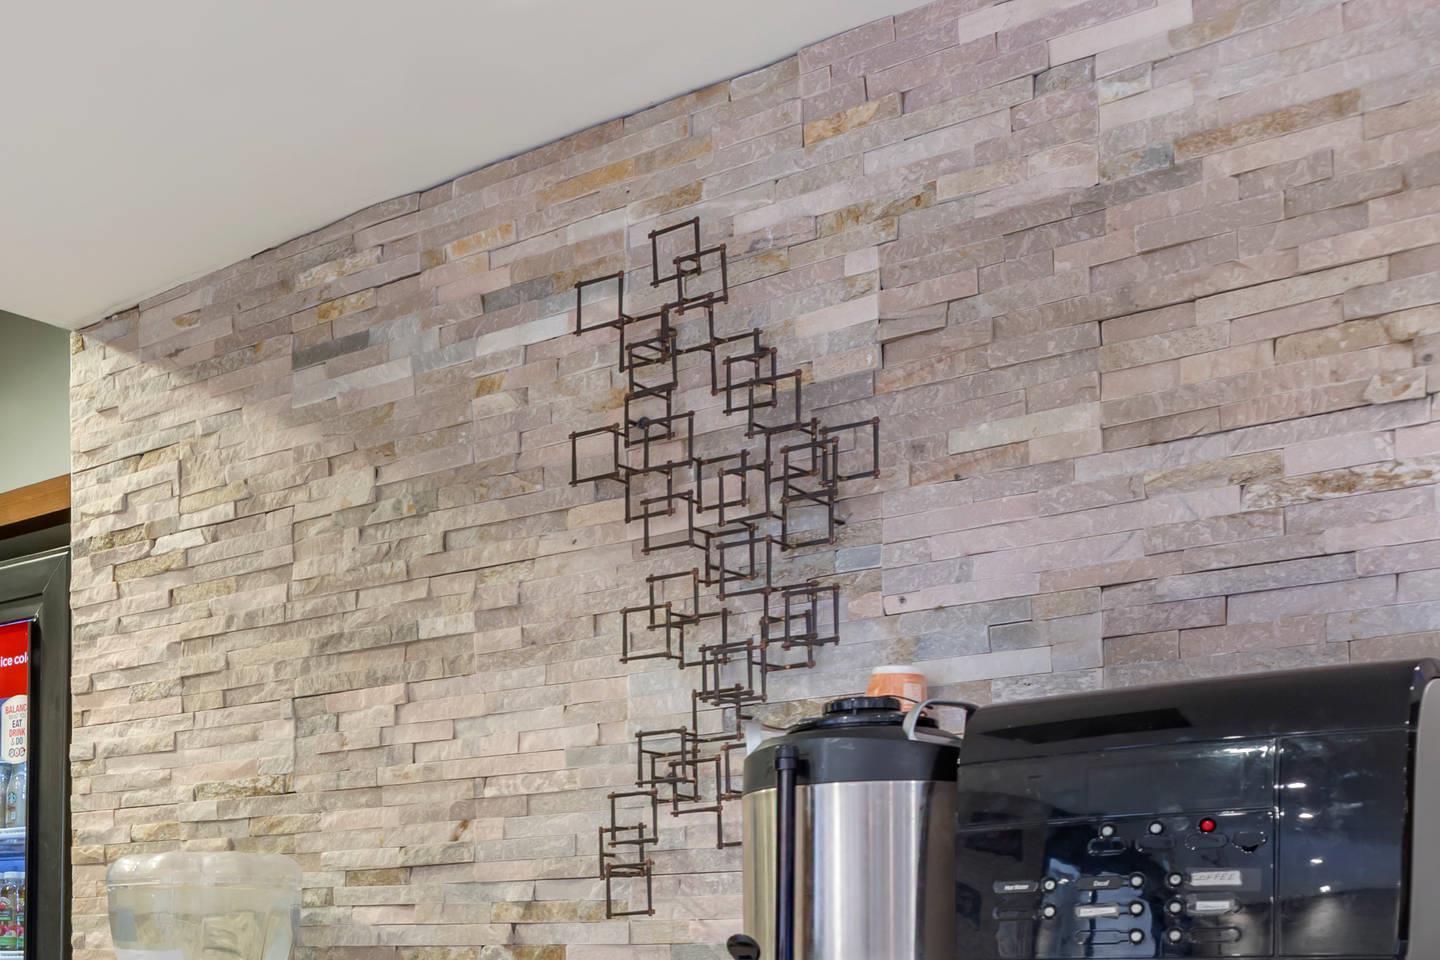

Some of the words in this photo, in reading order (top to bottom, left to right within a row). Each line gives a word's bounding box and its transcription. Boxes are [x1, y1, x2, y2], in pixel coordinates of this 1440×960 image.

[0, 656, 13, 667] ice
[14, 652, 28, 666] col
[5, 704, 27, 714] BALANC
[12, 719, 22, 728] EAT
[9, 728, 26, 737] DRINK
[16, 737, 24, 745] DO
